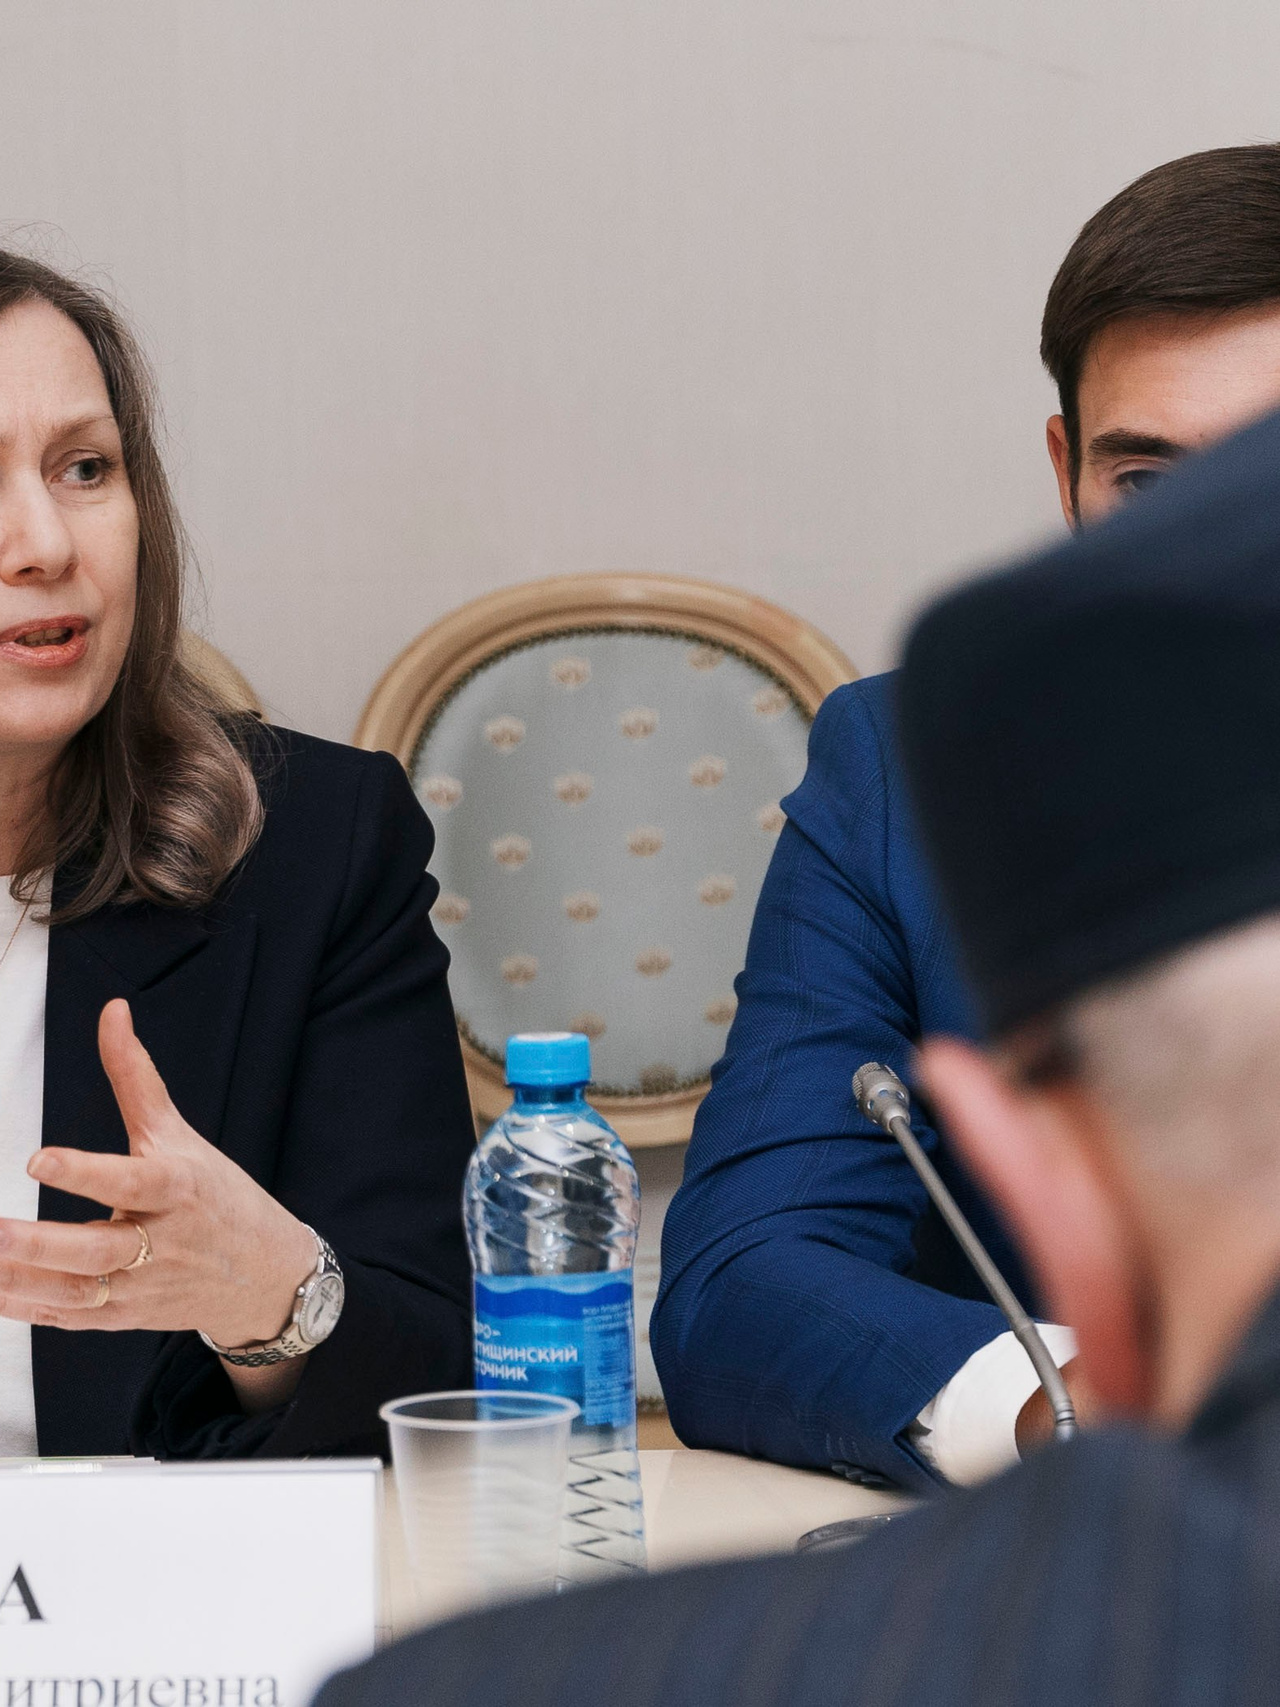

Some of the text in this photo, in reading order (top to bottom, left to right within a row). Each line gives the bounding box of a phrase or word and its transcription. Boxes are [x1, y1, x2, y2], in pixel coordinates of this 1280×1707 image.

[474, 1320, 501, 1340] РО-
[474, 1340, 578, 1363] ТИЩИНСКИЙ
[474, 1358, 528, 1382] ТОЧНИК
